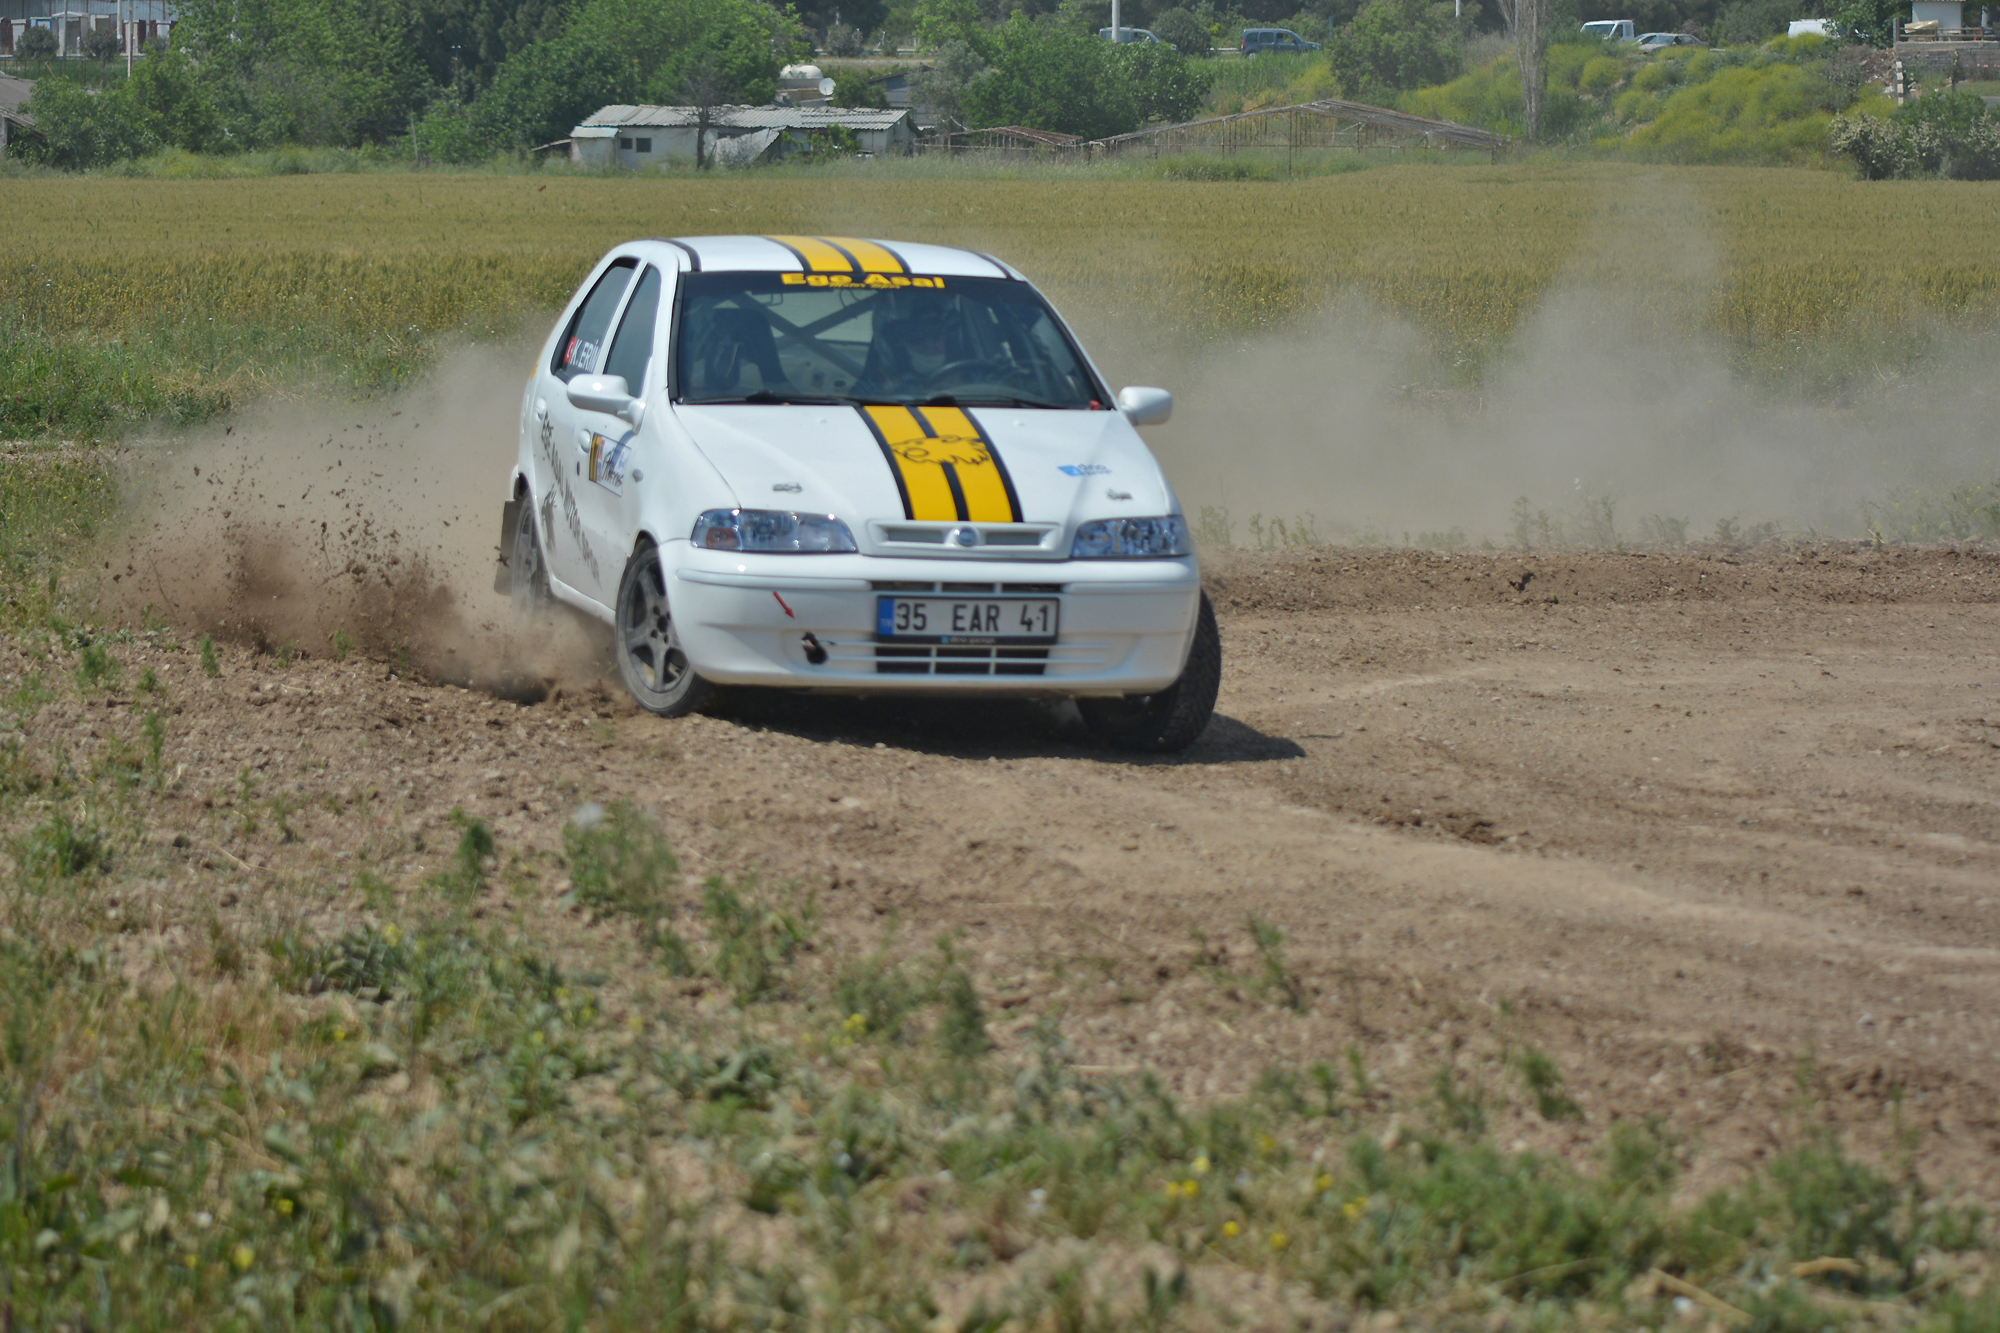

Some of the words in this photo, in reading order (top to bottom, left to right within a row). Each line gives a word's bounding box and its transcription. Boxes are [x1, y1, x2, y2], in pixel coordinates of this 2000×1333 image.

[864, 273, 946, 289] Asal
[896, 603, 927, 631] 35
[952, 604, 1000, 632] EAR
[1020, 604, 1049, 632] 41
